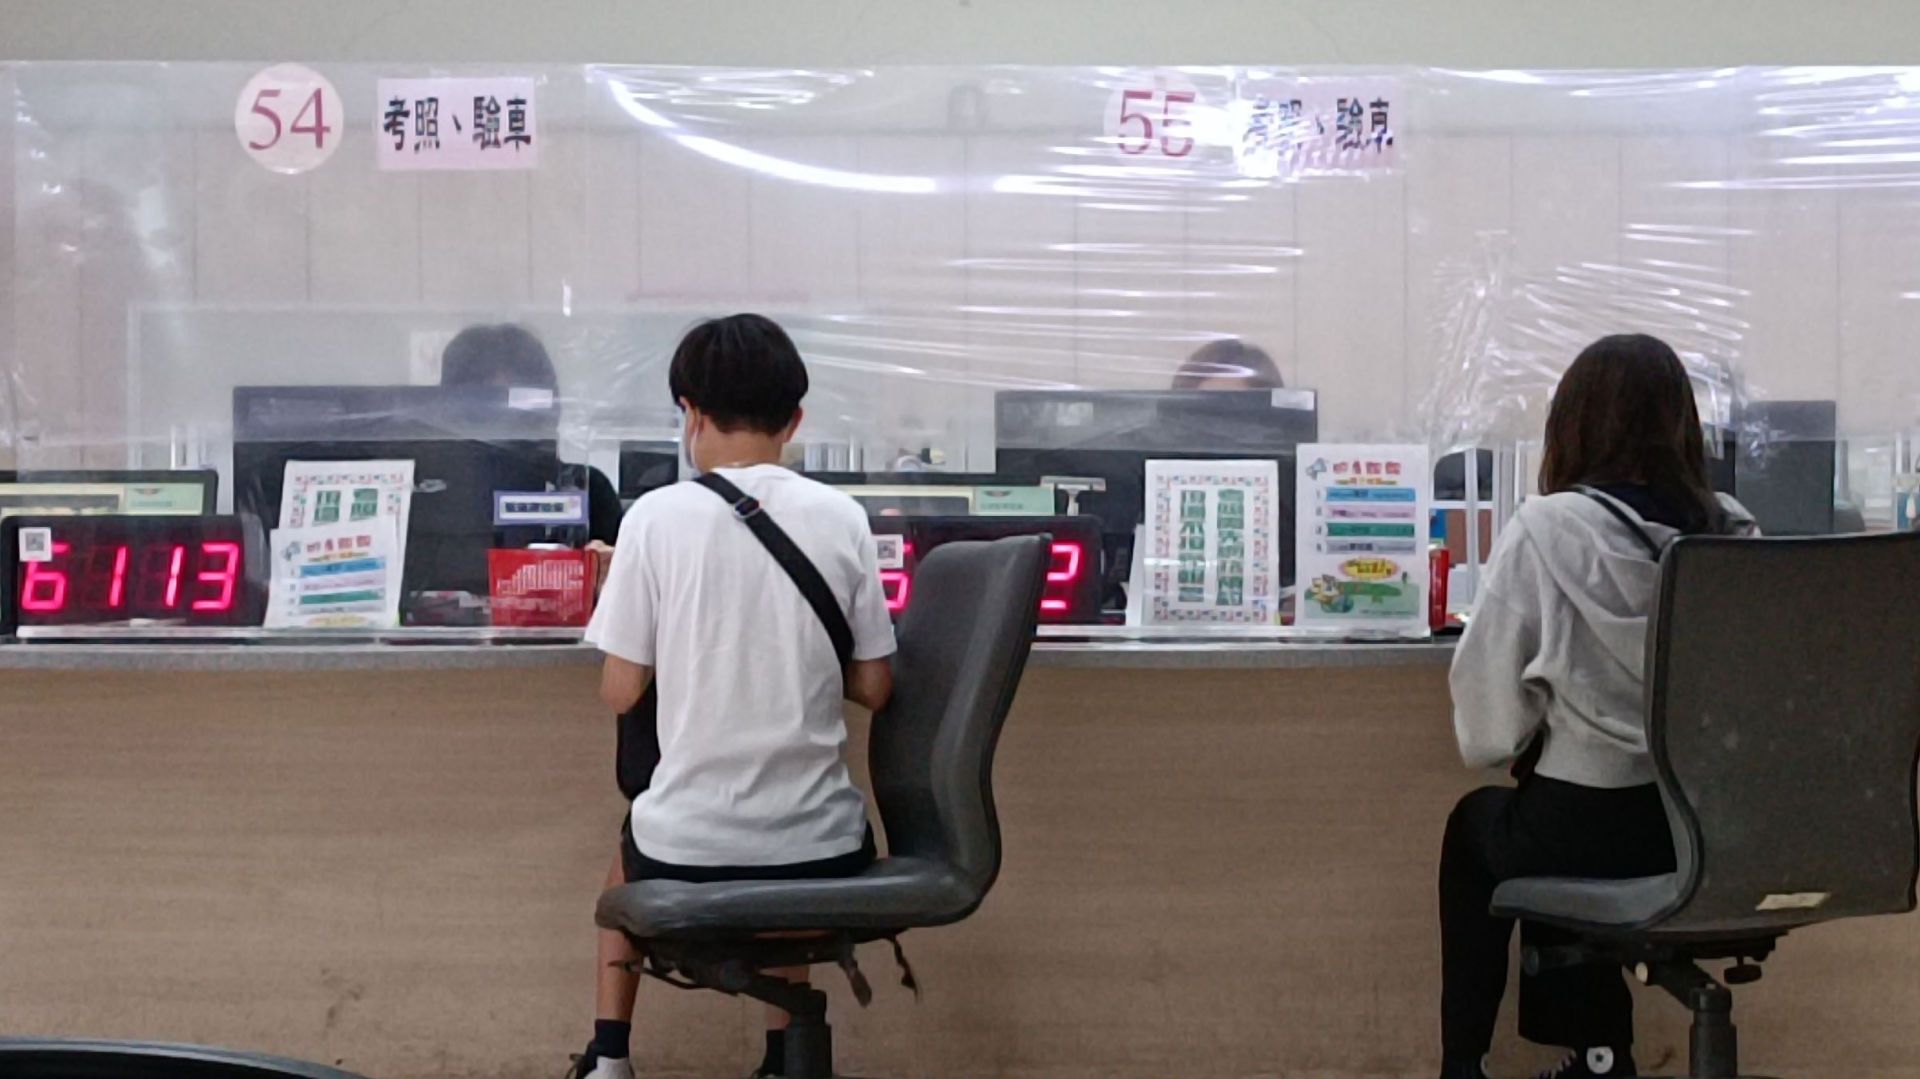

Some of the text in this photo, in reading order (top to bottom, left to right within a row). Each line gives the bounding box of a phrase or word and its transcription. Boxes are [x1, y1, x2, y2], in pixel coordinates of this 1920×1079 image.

[248, 87, 331, 151] 54
[1116, 89, 1196, 157] 55
[20, 541, 241, 611] 6113
